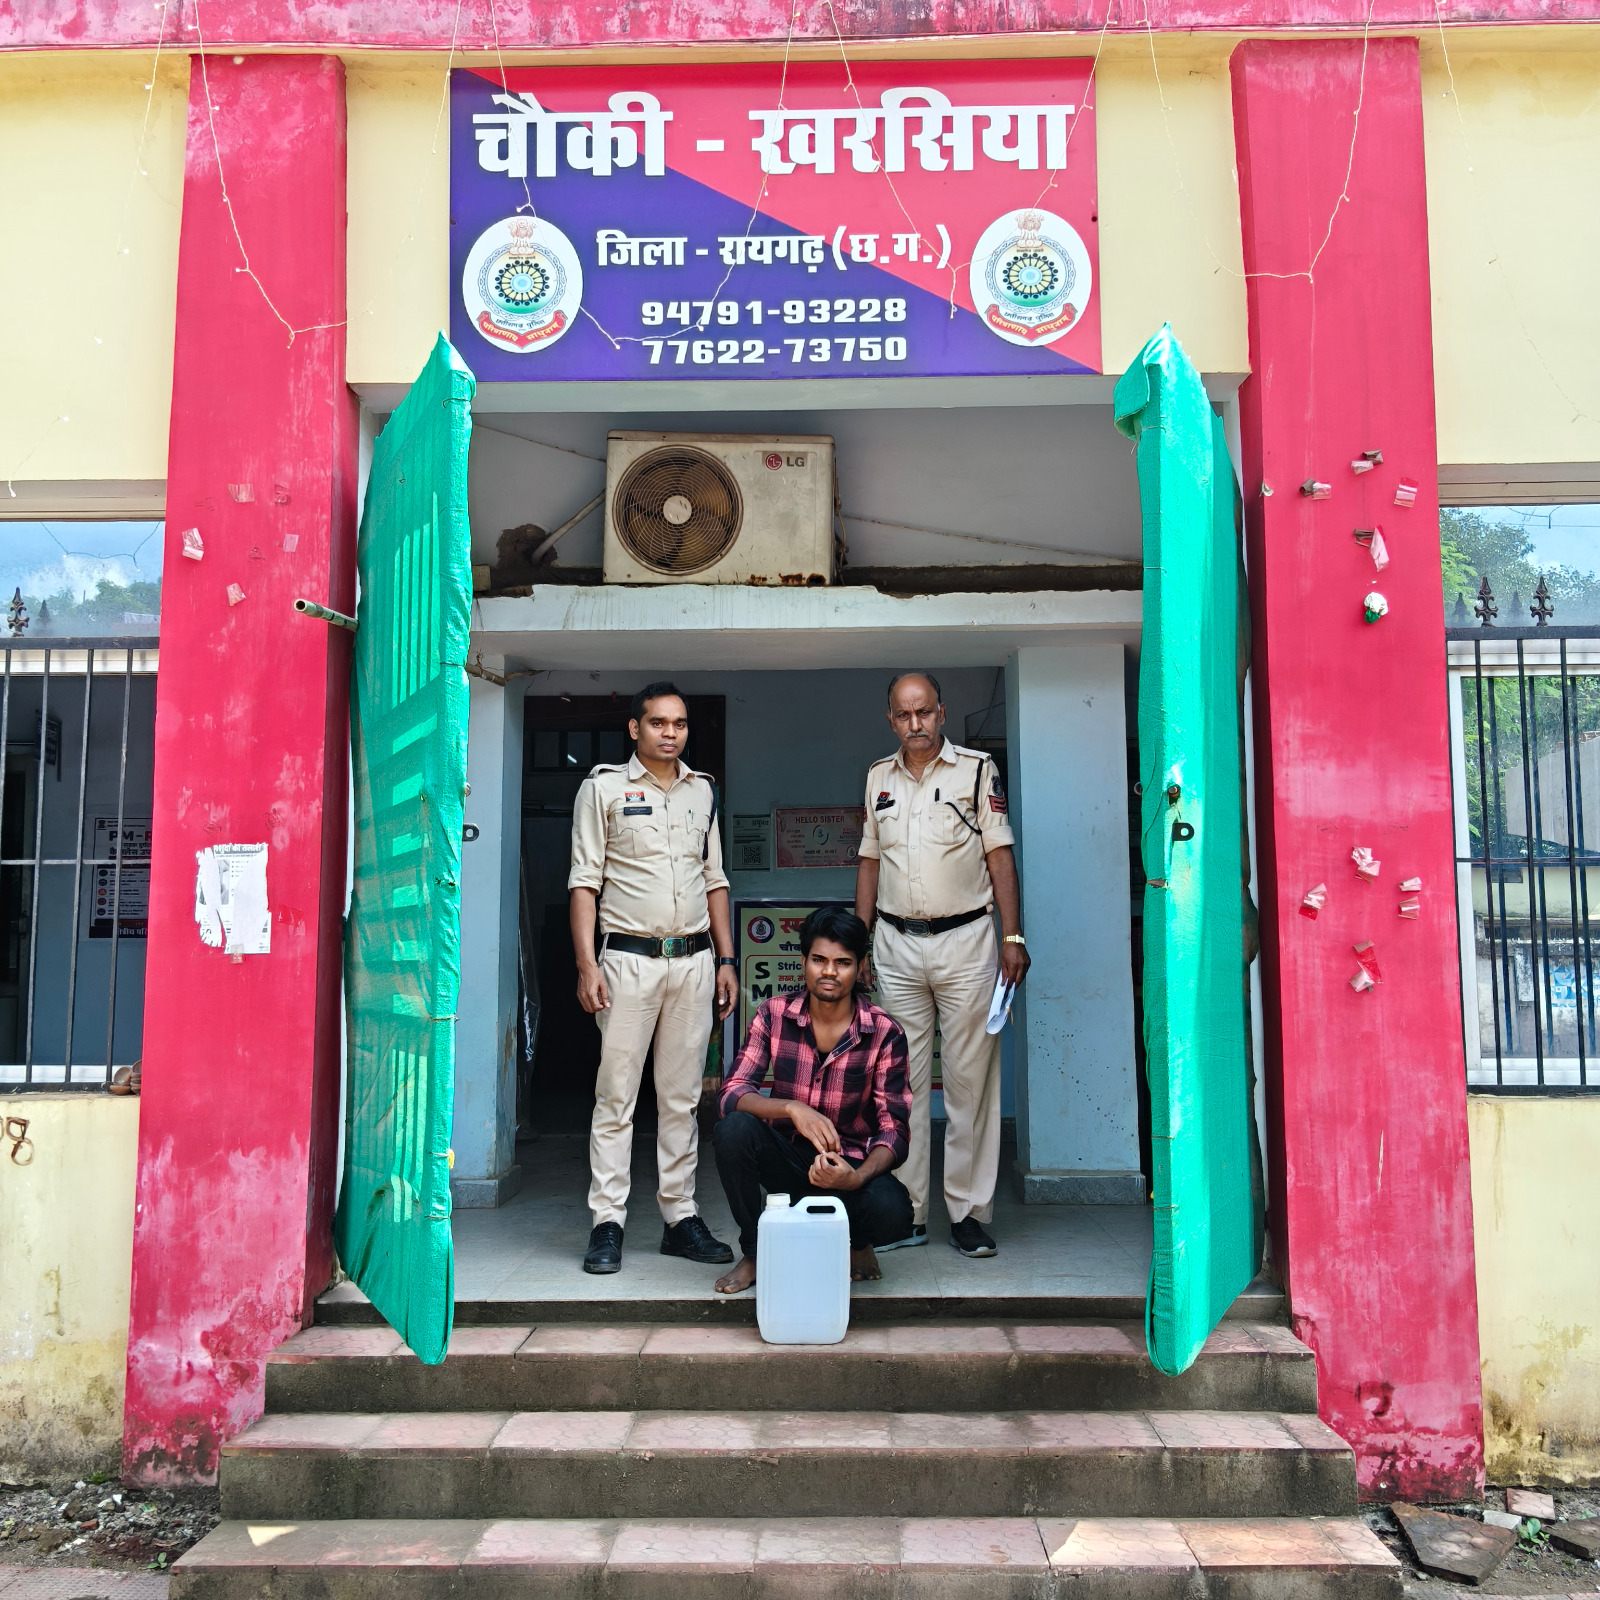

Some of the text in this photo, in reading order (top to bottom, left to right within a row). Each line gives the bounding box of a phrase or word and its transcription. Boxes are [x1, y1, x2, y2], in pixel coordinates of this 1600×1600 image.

[472, 91, 674, 178] चौकी
[748, 86, 1075, 175] खरसिया
[595, 229, 688, 266] जिला
[717, 234, 825, 273] रायगढ़
[832, 224, 952, 271] (छ.ग.)
[641, 298, 907, 326] 94791-93228
[641, 336, 907, 365] 77622-73750
[786, 456, 805, 467] LG
[795, 815, 845, 824] HELLO SISTER
[754, 961, 802, 980] S Stric
